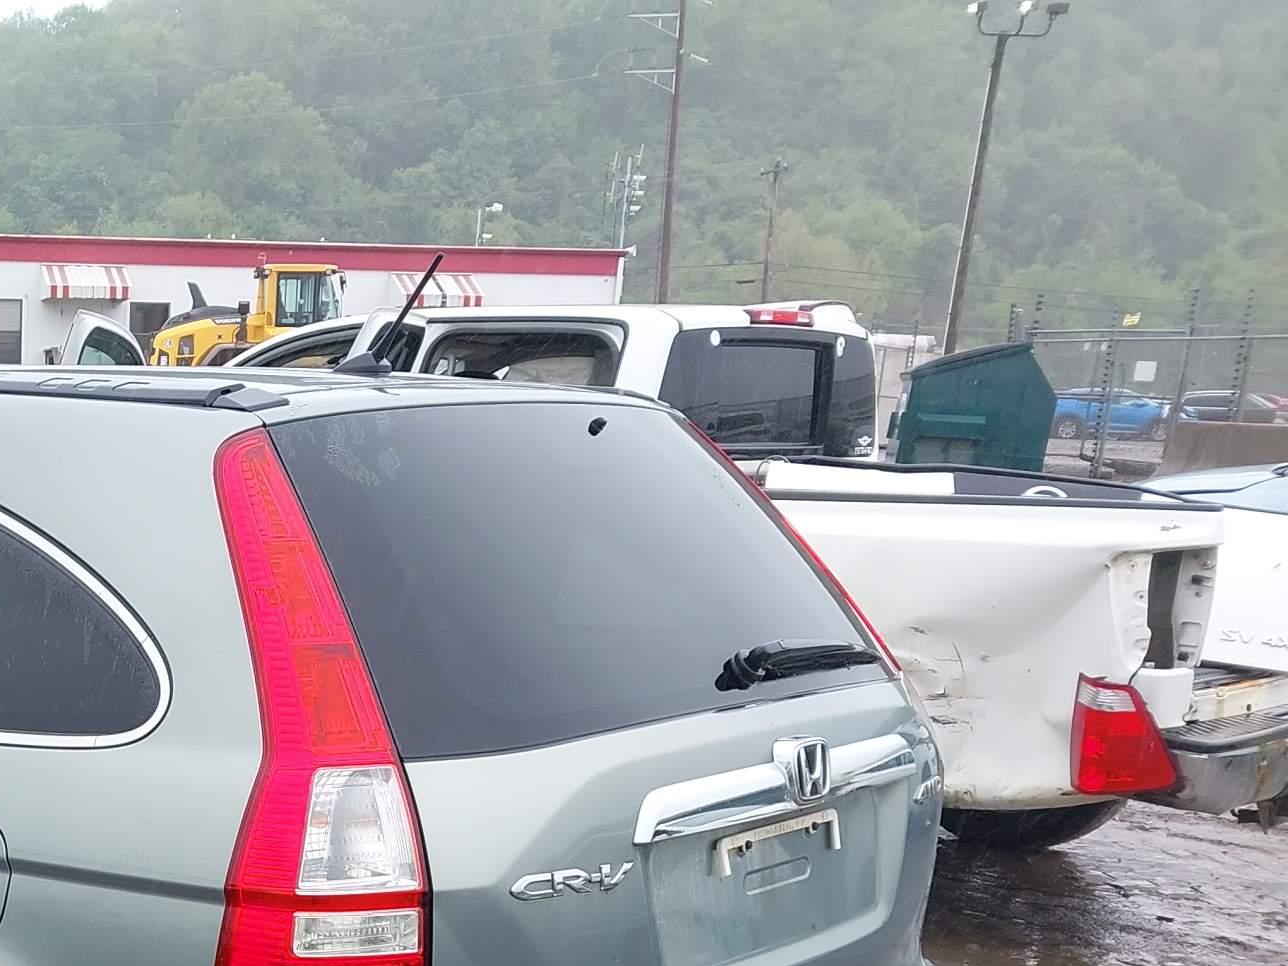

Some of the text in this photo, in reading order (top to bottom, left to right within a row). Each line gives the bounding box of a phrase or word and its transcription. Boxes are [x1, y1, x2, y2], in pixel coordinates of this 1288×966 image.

[1219, 629, 1288, 650] SV 4X
[509, 861, 634, 901] CR-V
